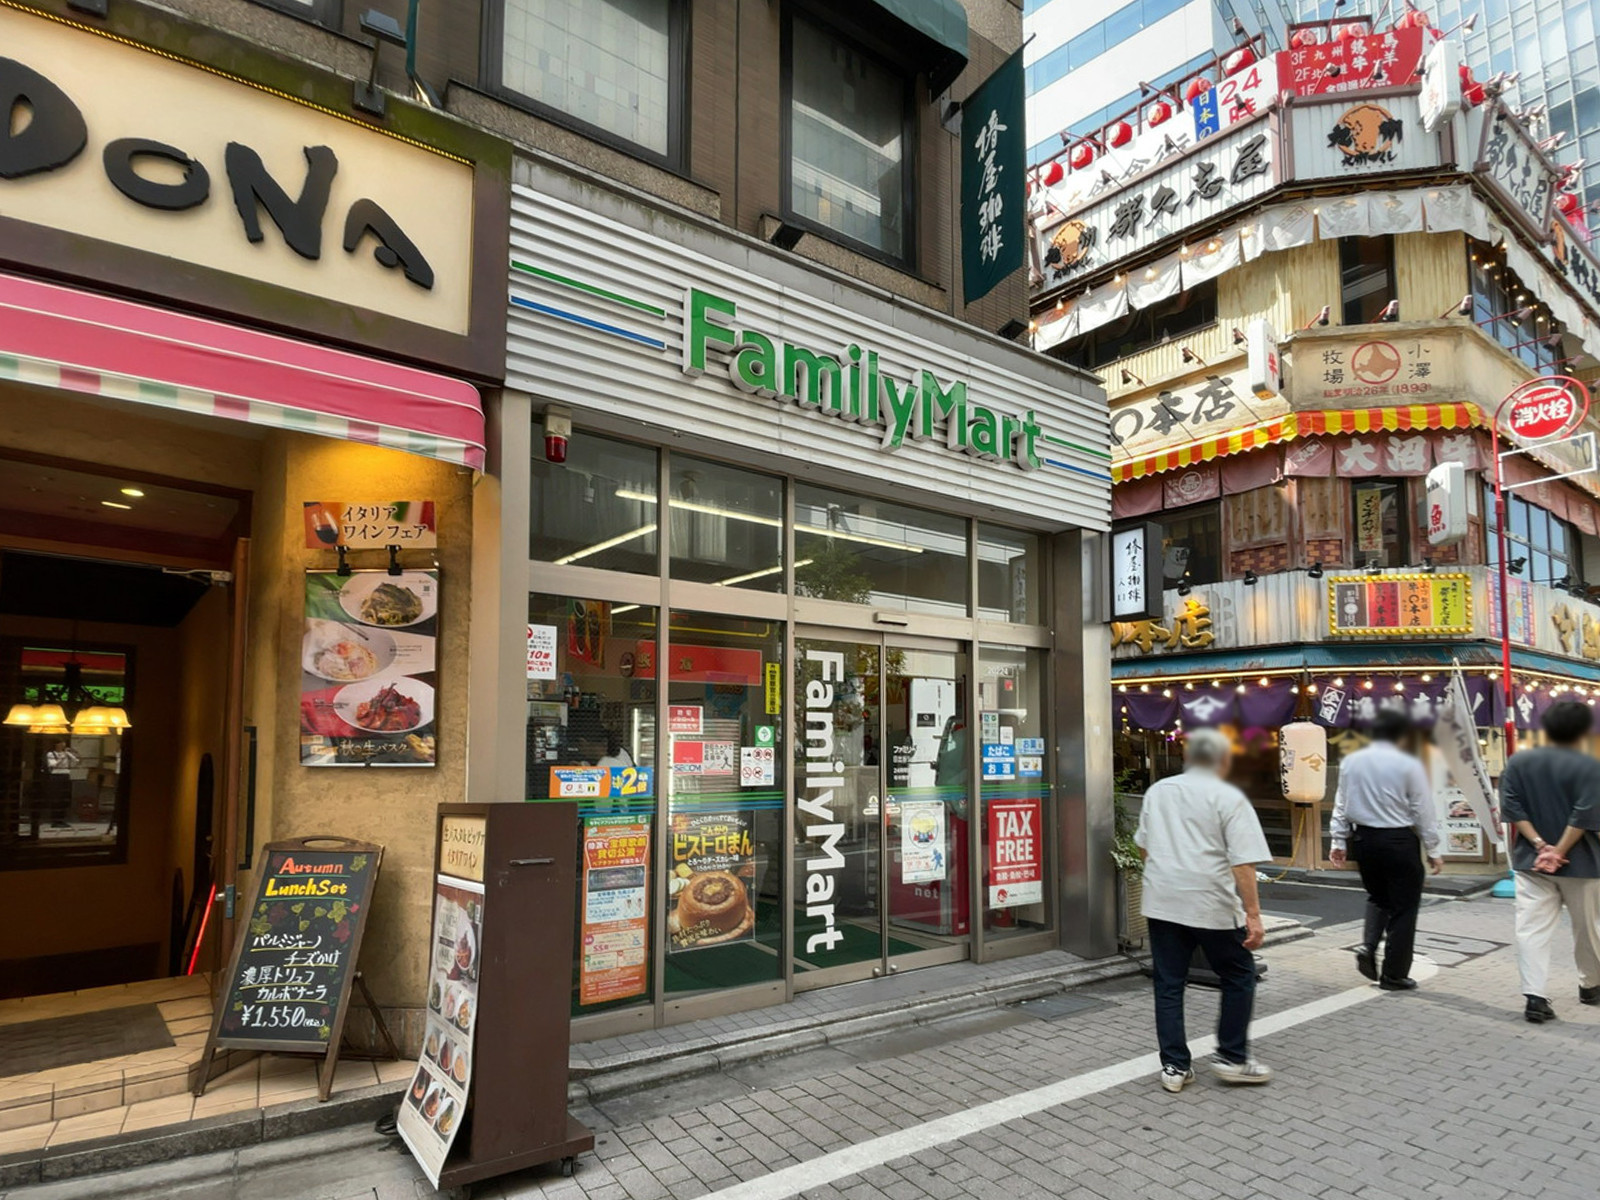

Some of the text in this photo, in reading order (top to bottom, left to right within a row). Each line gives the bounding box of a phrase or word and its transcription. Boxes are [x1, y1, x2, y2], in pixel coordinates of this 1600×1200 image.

[683, 286, 1043, 470] FamilyMart
[1322, 350, 1345, 385] 牧場
[1514, 397, 1569, 428] 消火栓
[342, 505, 398, 523] イタリア
[343, 523, 428, 540] ワインフェア
[988, 746, 1010, 757] たばこ
[674, 764, 702, 772] SECOM
[797, 650, 845, 953] FamilyMart
[996, 810, 1033, 837] TAX
[673, 829, 754, 861] ビストロまん
[996, 838, 1034, 863] FREE
[279, 857, 344, 874] Autumn
[257, 985, 328, 1001] カルボナーラ
